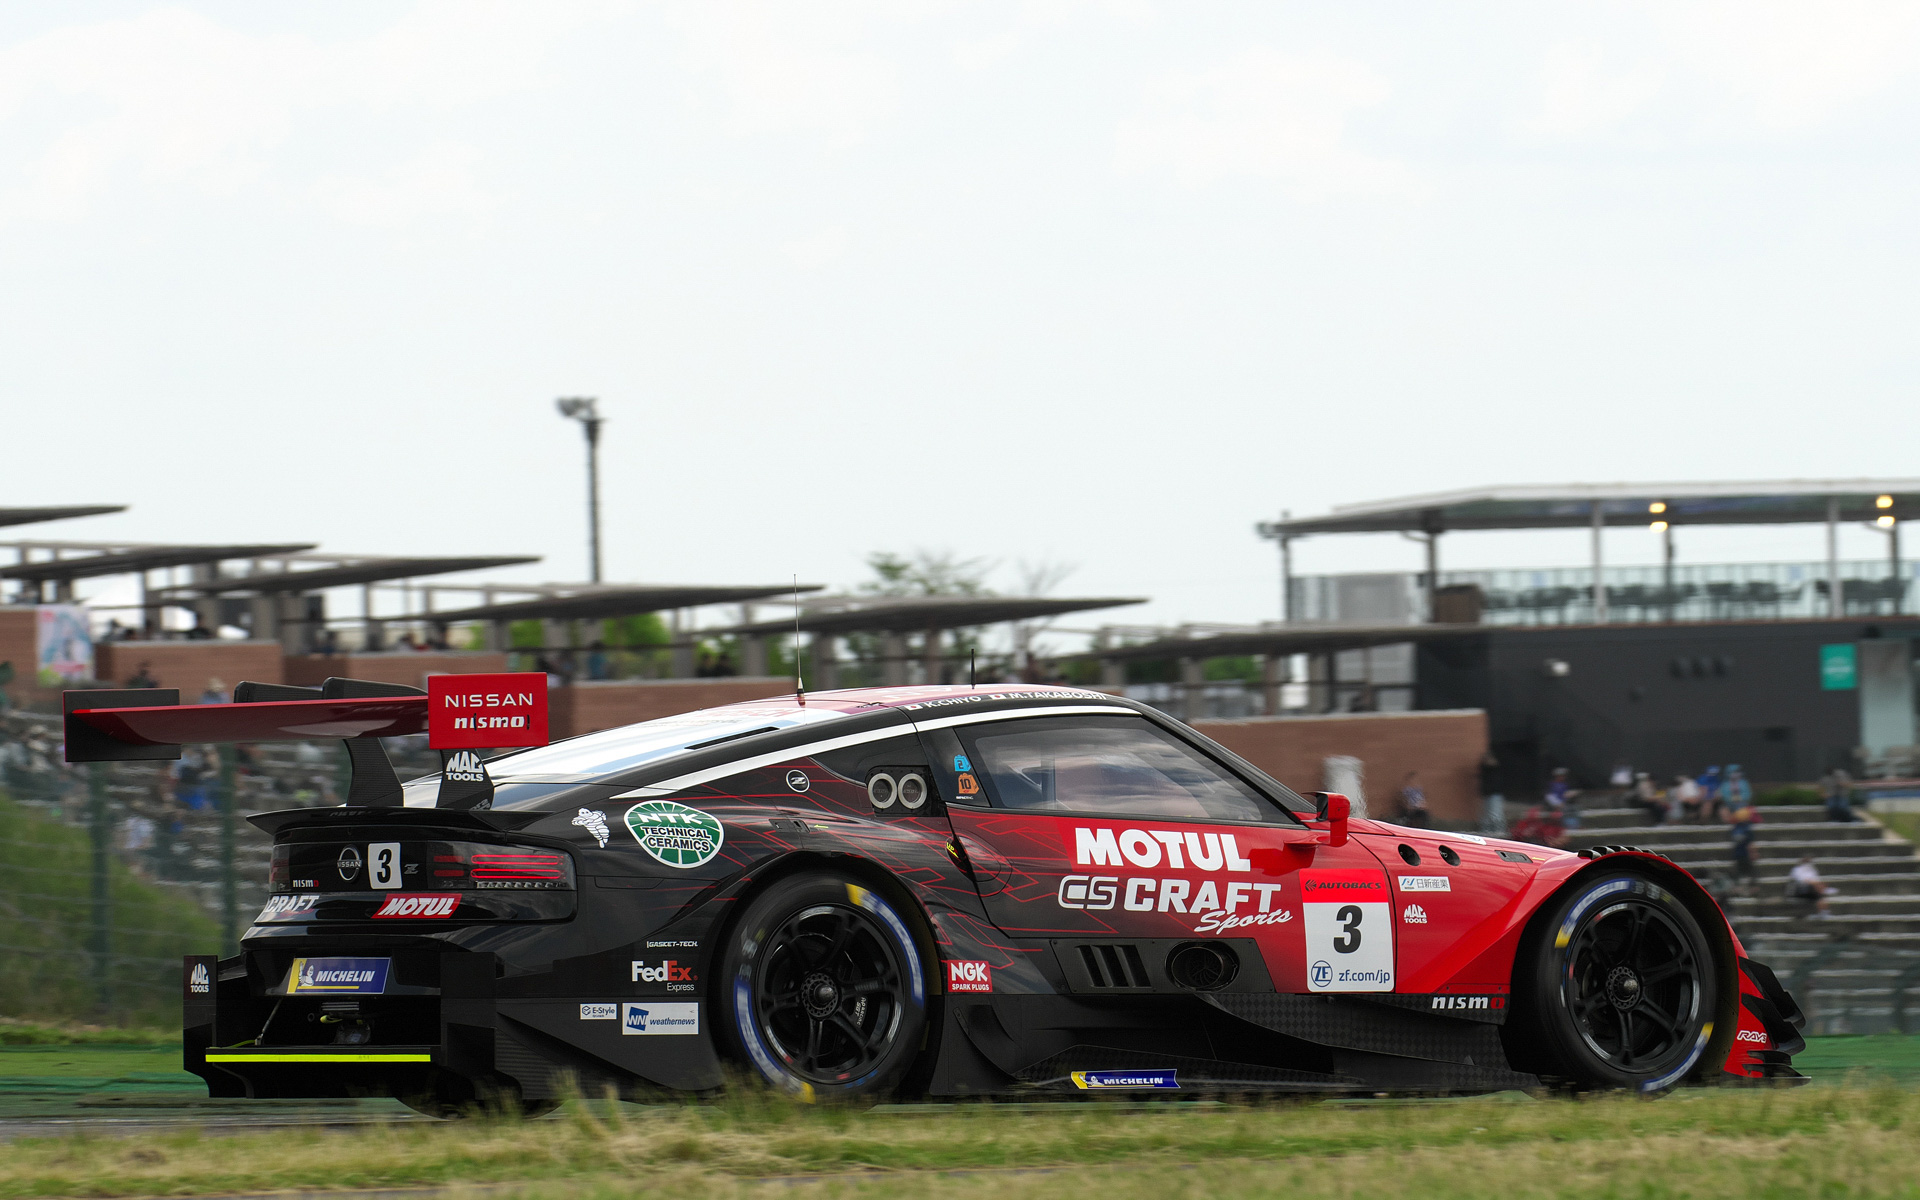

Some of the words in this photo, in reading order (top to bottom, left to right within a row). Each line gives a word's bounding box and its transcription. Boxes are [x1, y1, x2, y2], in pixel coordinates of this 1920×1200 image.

[445, 693, 533, 708] NISSAN
[454, 716, 525, 729] nismo
[446, 751, 484, 773] MAC
[957, 760, 964, 769] 2
[446, 772, 484, 782] TOOLS
[960, 778, 971, 790] 10
[637, 813, 702, 825] NTK
[642, 827, 711, 839] TECHNICAL
[648, 837, 710, 852] CERAMICS
[1075, 827, 1251, 872] MOTUL
[377, 849, 392, 884] 3
[1318, 881, 1382, 890] AUTOBACS
[265, 895, 320, 912] CRAFT
[1123, 878, 1282, 914] CRAFT
[377, 897, 455, 916] MOTUL
[1403, 903, 1427, 918] MAC
[1194, 909, 1294, 935] Sports
[1333, 904, 1363, 954] 3
[190, 963, 210, 985] MAC
[315, 970, 375, 982] MICHELIN
[631, 960, 692, 982] FedEx
[950, 962, 988, 982] NGK
[1313, 966, 1331, 982] ZF
[1338, 969, 1391, 984] zf.com/jp
[190, 984, 210, 993] TOOLS
[666, 983, 695, 993] Express
[952, 983, 971, 991] SPARK
[971, 983, 990, 991] PLUGS
[592, 1006, 616, 1016] E-Style
[649, 1017, 696, 1026] weathernews
[1737, 1030, 1768, 1043] RAYS
[1103, 1077, 1164, 1085] MICHELIN
